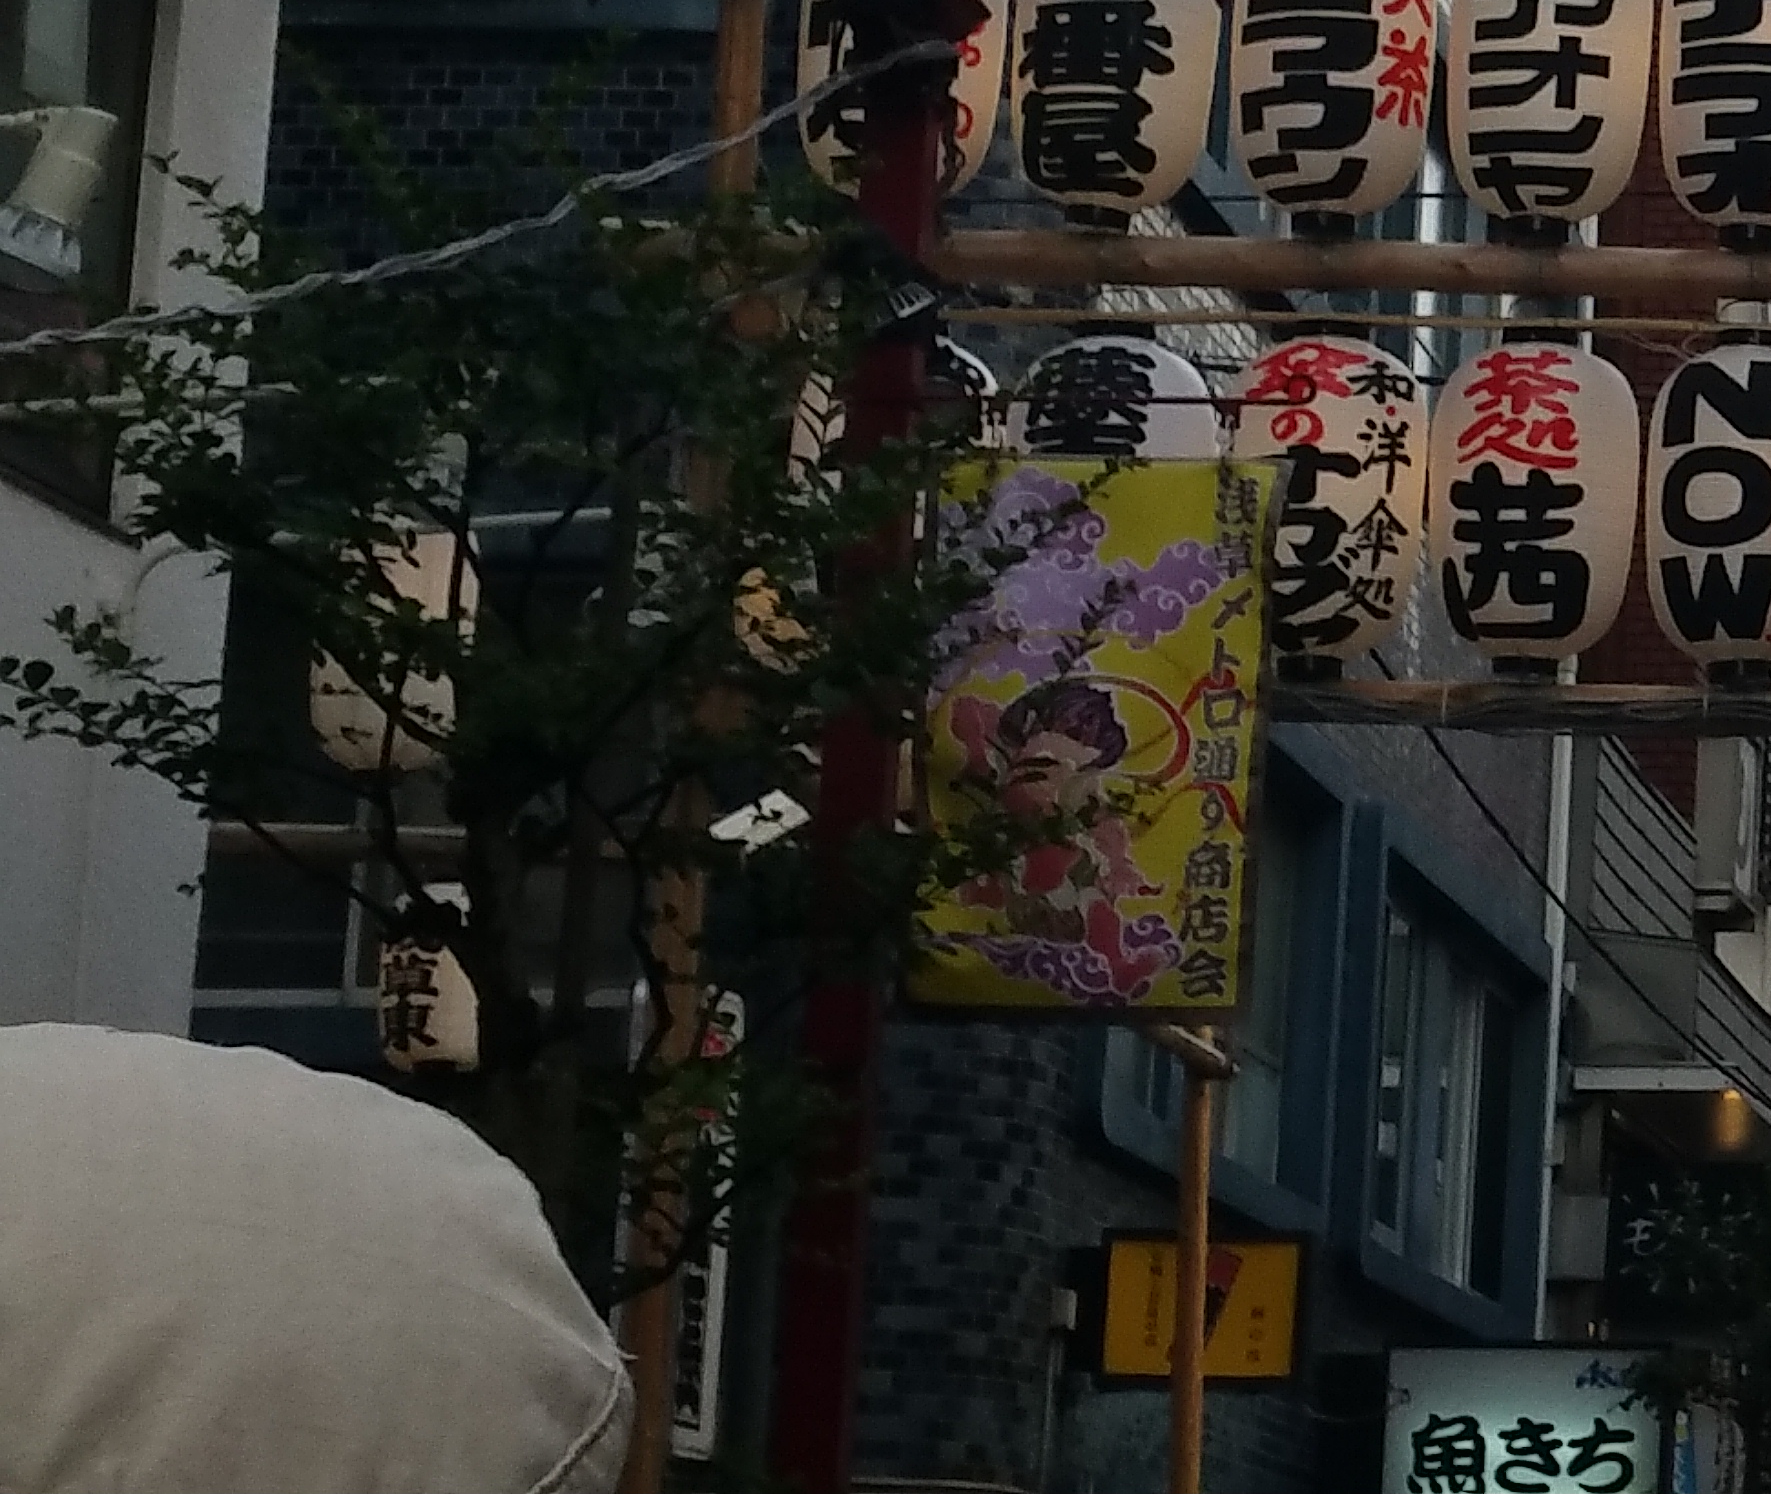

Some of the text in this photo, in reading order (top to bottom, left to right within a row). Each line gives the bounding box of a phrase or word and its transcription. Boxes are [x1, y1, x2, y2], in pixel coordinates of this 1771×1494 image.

[1182, 477, 1260, 999] 浅草メトロ通り商店会
[1406, 1413, 1636, 1493] 魚きち
